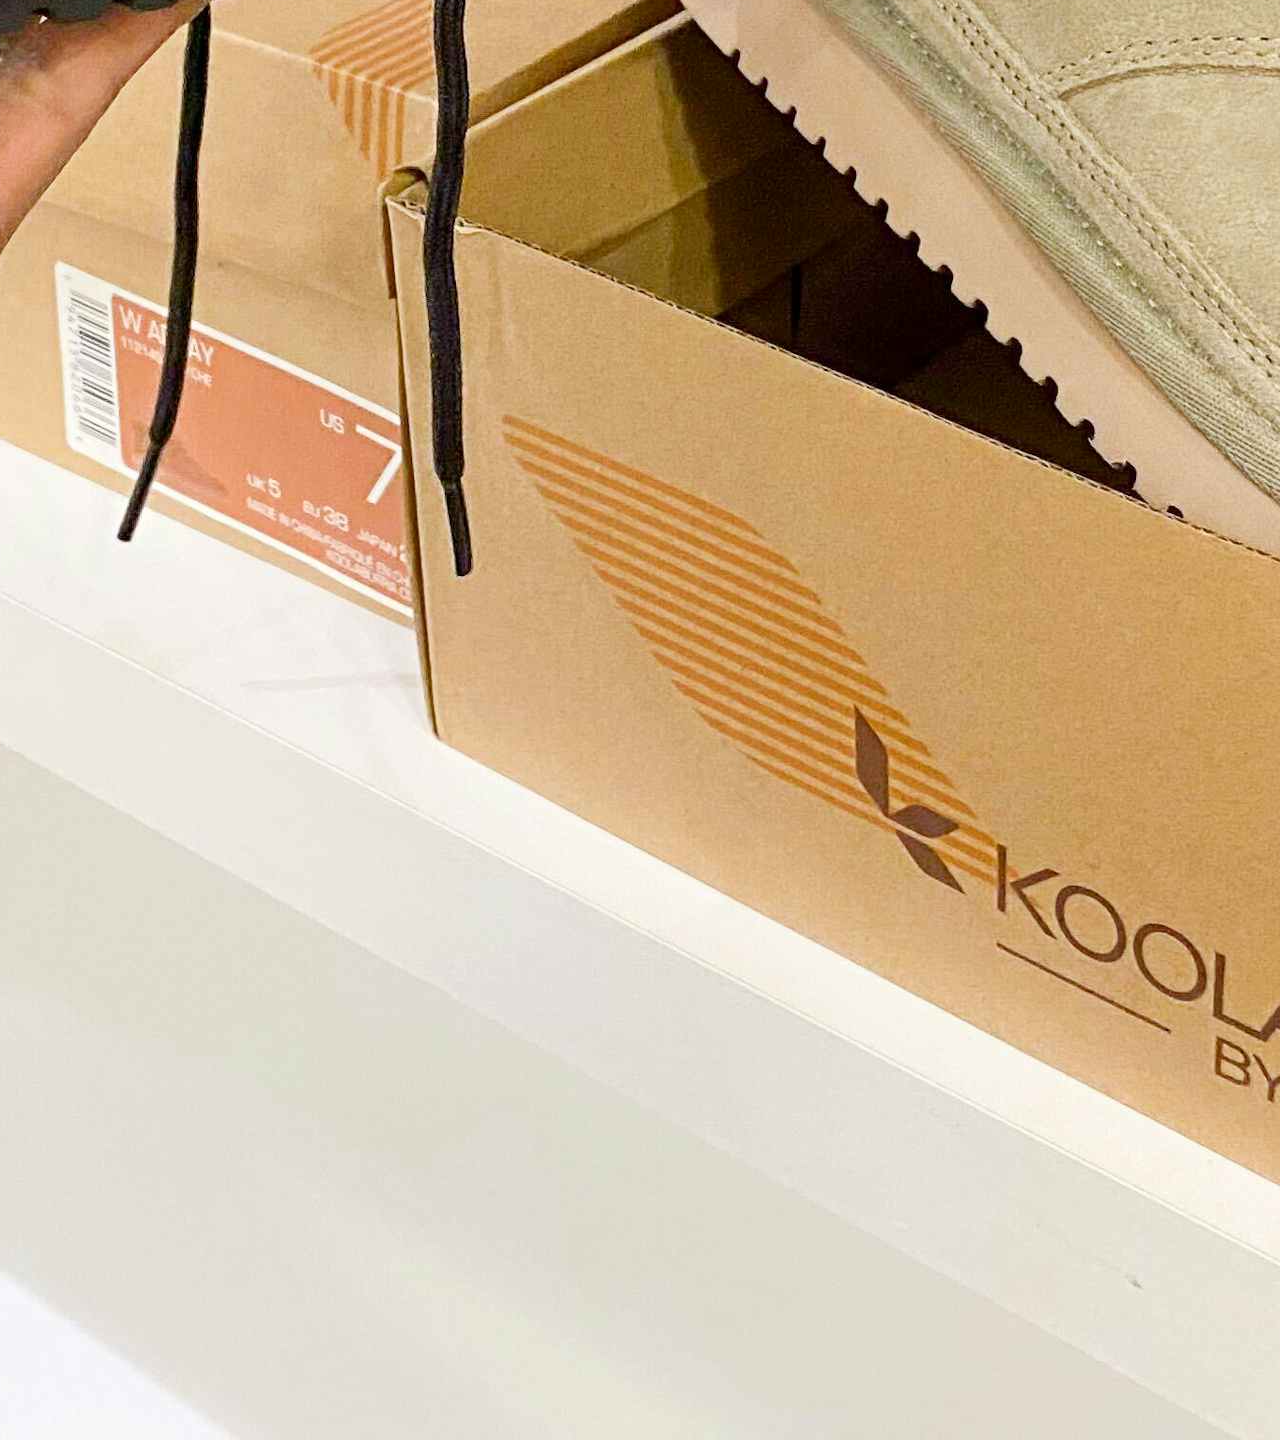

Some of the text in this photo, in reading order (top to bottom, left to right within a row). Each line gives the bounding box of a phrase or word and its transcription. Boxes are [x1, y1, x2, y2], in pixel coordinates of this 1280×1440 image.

[119, 303, 143, 335] W
[320, 408, 403, 505] US 7
[323, 505, 350, 532] 38
